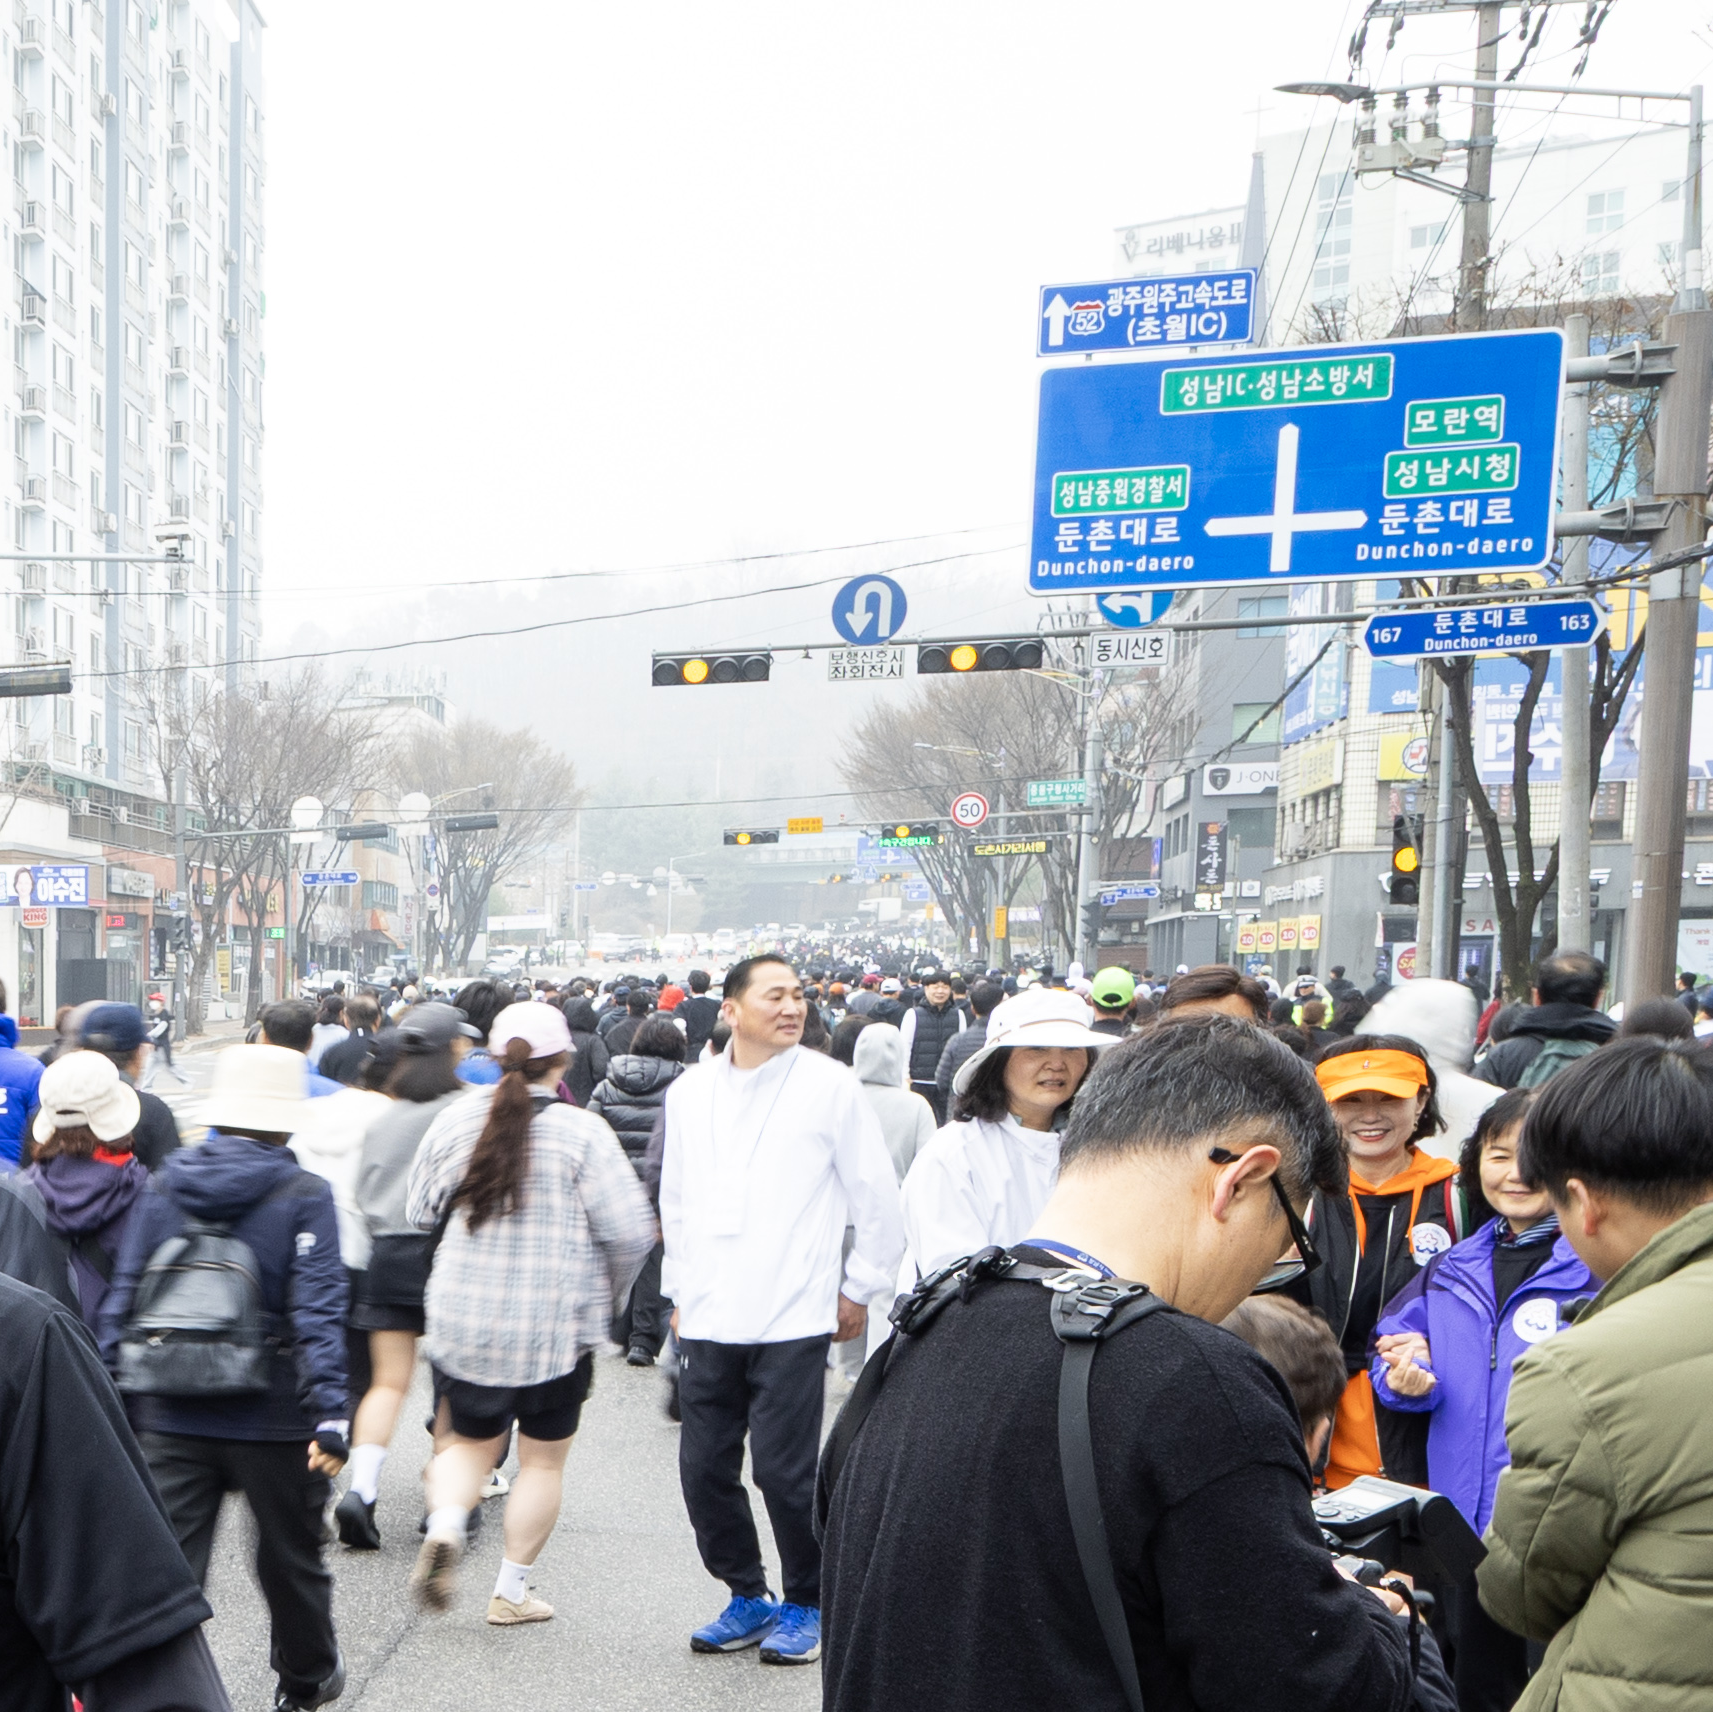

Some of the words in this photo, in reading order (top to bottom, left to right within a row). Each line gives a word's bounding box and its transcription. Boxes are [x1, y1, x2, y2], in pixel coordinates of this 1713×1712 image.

[1106, 278, 1248, 318] 광주원주고속도로
[1076, 311, 1098, 331] 52
[1126, 310, 1228, 345] (초월IC)
[1178, 362, 1375, 407] 성남IC·성남소방서
[1411, 404, 1498, 435] 모란역
[1393, 452, 1511, 489] 성남시청
[1059, 474, 1183, 509] 성남중원경찰서
[1378, 498, 1515, 536] 둔촌대로
[1054, 516, 1181, 553] 둔촌대로
[1356, 537, 1534, 561] Dunchon-daero
[1037, 555, 1195, 577] Dunchon-daero
[1433, 607, 1529, 635] 둔촌대로
[1560, 614, 1590, 631] 163
[1371, 627, 1402, 644] 167
[1424, 633, 1538, 652] Dunchon-daero
[1096, 638, 1165, 662] 동시신호
[959, 803, 980, 818] 50
[36, 876, 87, 903] 이수진
[23, 912, 48, 922] KING
[1241, 936, 1253, 944] 10
[1261, 934, 1273, 943] 10
[1282, 930, 1295, 939] 10
[1304, 928, 1317, 938] 10
